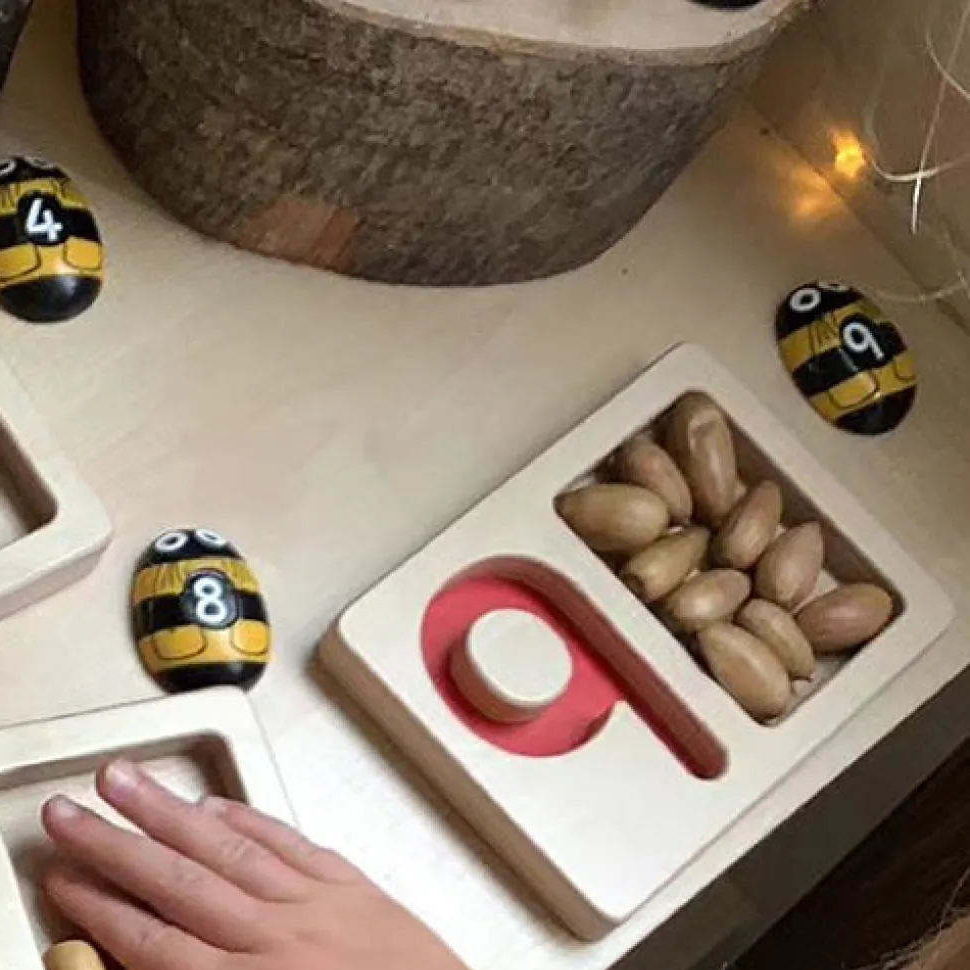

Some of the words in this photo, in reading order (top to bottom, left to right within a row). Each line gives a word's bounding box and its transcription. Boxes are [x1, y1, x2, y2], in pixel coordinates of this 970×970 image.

[24, 198, 62, 242] 4
[842, 322, 883, 360] 9
[193, 577, 229, 625] 8
[421, 553, 729, 782] 9
